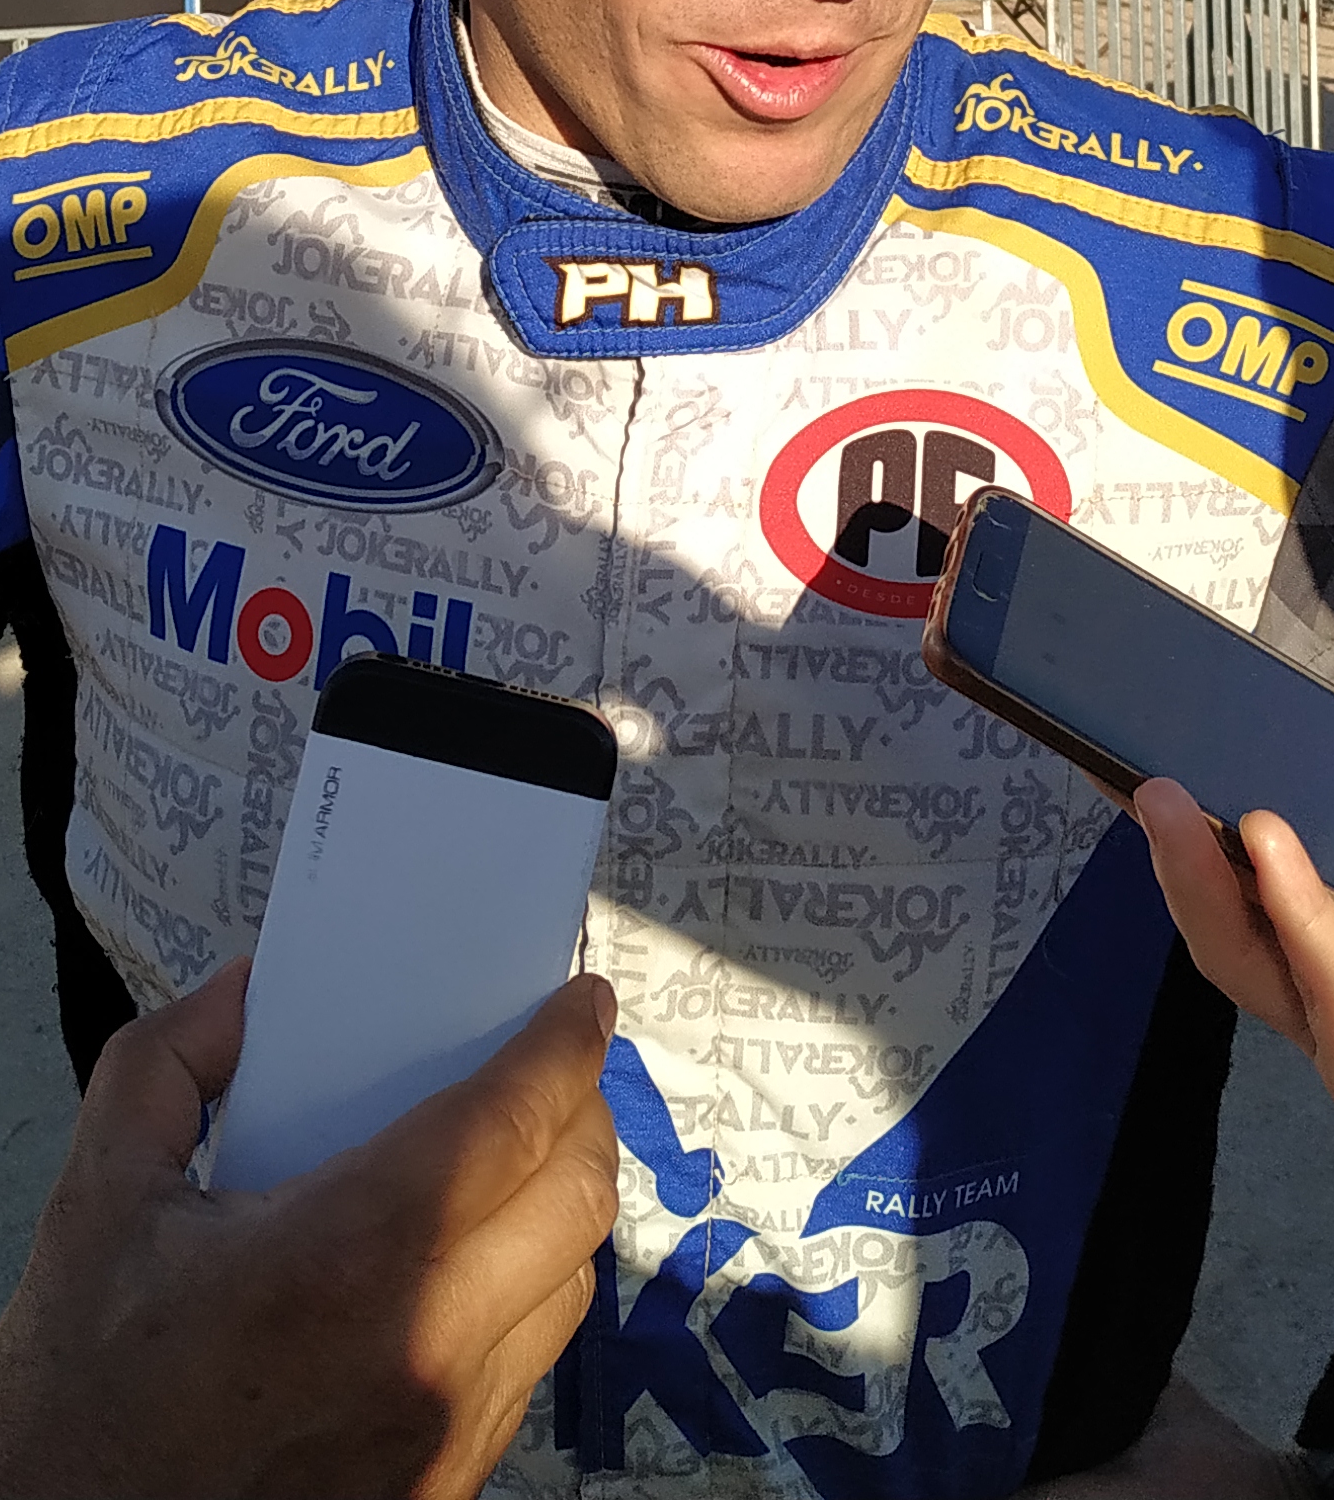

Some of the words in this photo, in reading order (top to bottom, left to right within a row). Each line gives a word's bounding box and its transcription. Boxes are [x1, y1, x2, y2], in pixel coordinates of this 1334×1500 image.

[12, 185, 148, 259] OMP
[556, 260, 717, 326] PH
[1167, 302, 1330, 397] OMP
[230, 367, 421, 478] Ford
[315, 766, 343, 839] ARMOR
[866, 1188, 947, 1220] RALLY
[954, 1171, 1019, 1209] TEAM
